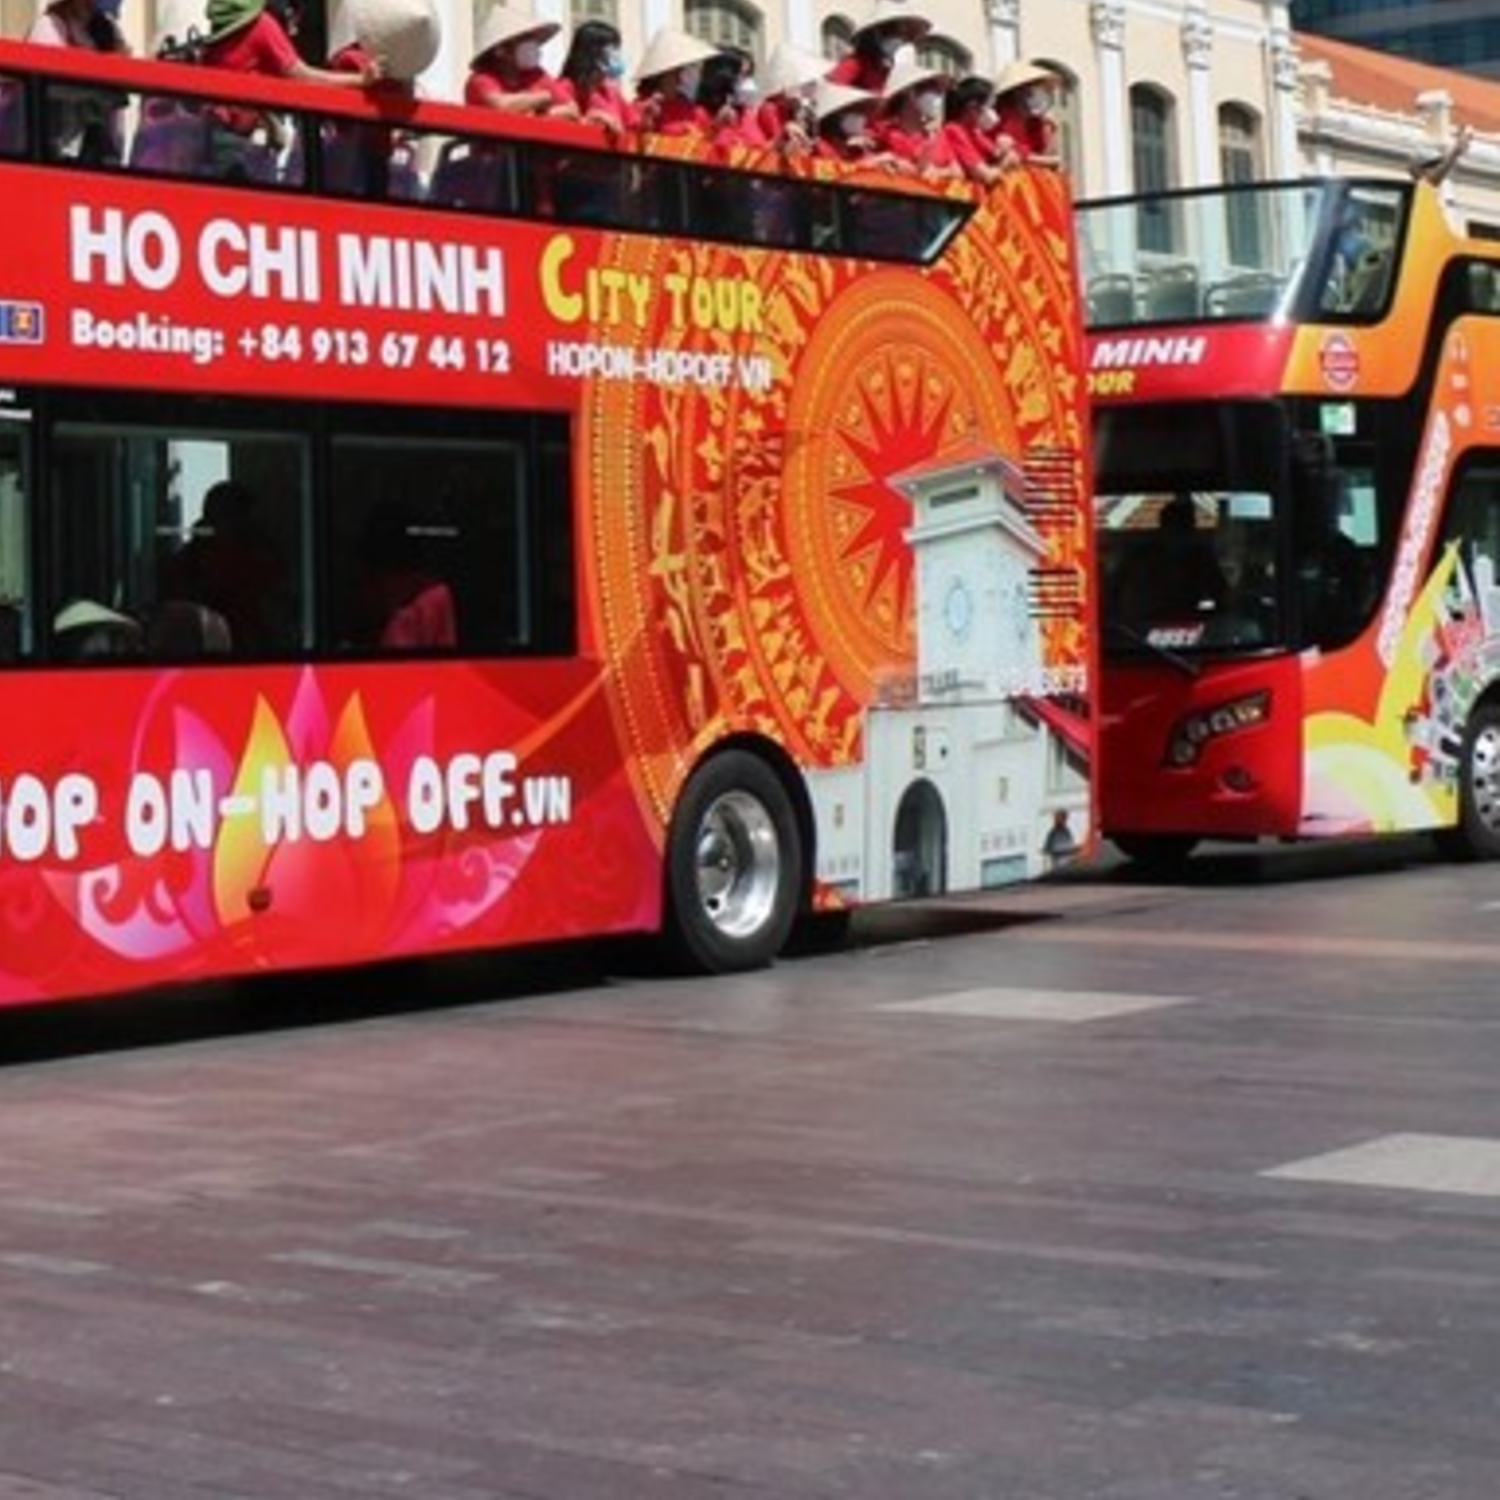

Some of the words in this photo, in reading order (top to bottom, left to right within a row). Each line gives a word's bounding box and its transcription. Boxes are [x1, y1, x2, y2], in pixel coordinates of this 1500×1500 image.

[69, 205, 181, 291] HO
[198, 218, 321, 303] CHI
[337, 233, 507, 318] MINH
[71, 309, 224, 363] Booking:
[238, 323, 301, 362] +84
[311, 329, 369, 365] 913
[380, 332, 419, 369] 67
[428, 336, 466, 371] 44
[474, 339, 510, 374] 12
[1091, 336, 1207, 369] MINH
[407, 750, 571, 834] OFF.VN
